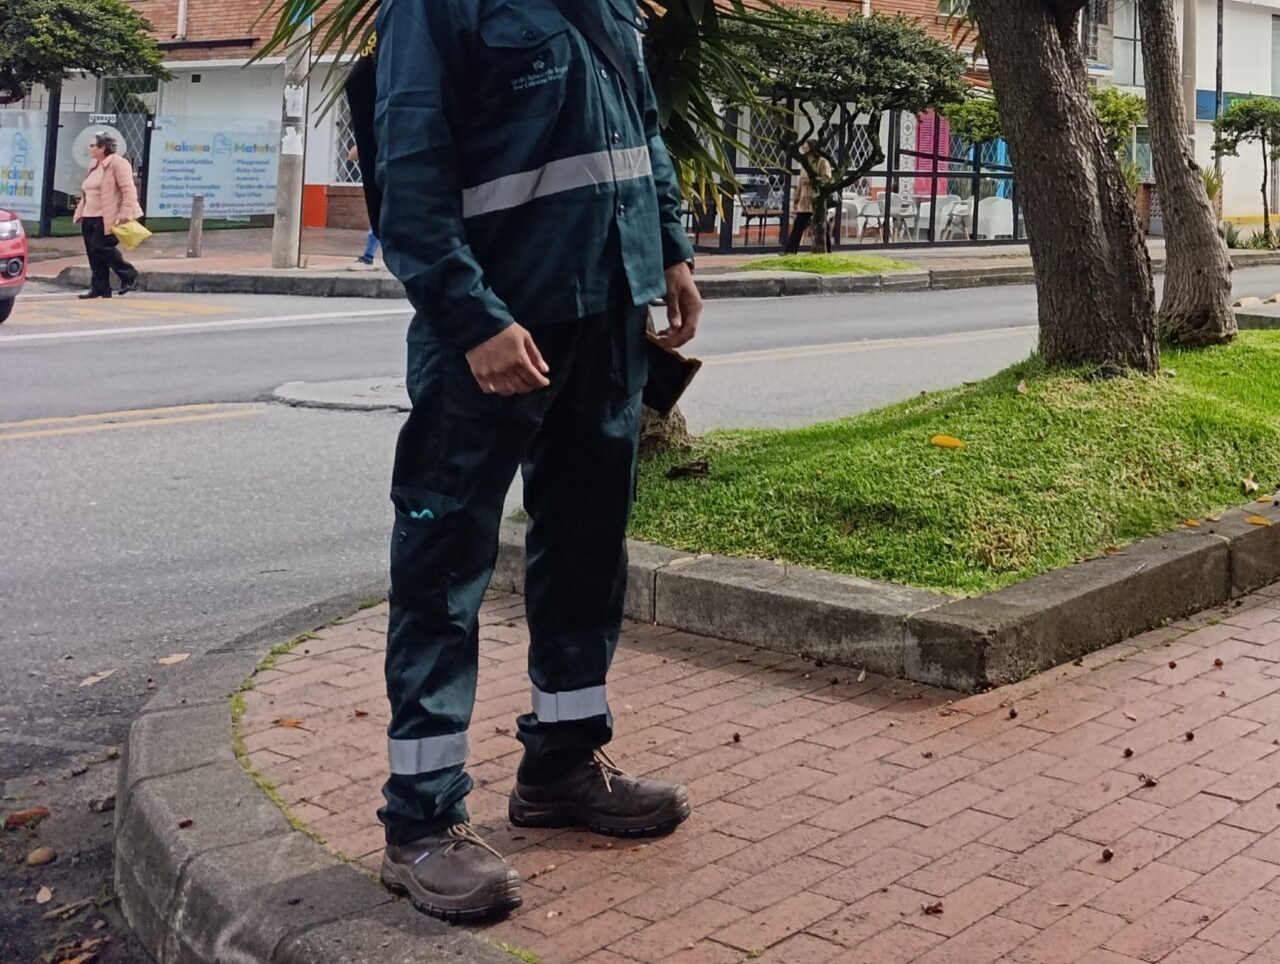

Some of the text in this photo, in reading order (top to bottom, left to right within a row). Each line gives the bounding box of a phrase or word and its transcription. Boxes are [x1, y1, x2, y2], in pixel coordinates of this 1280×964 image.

[164, 141, 277, 153] Hakuna Matata
[1, 165, 35, 180] Hakuna
